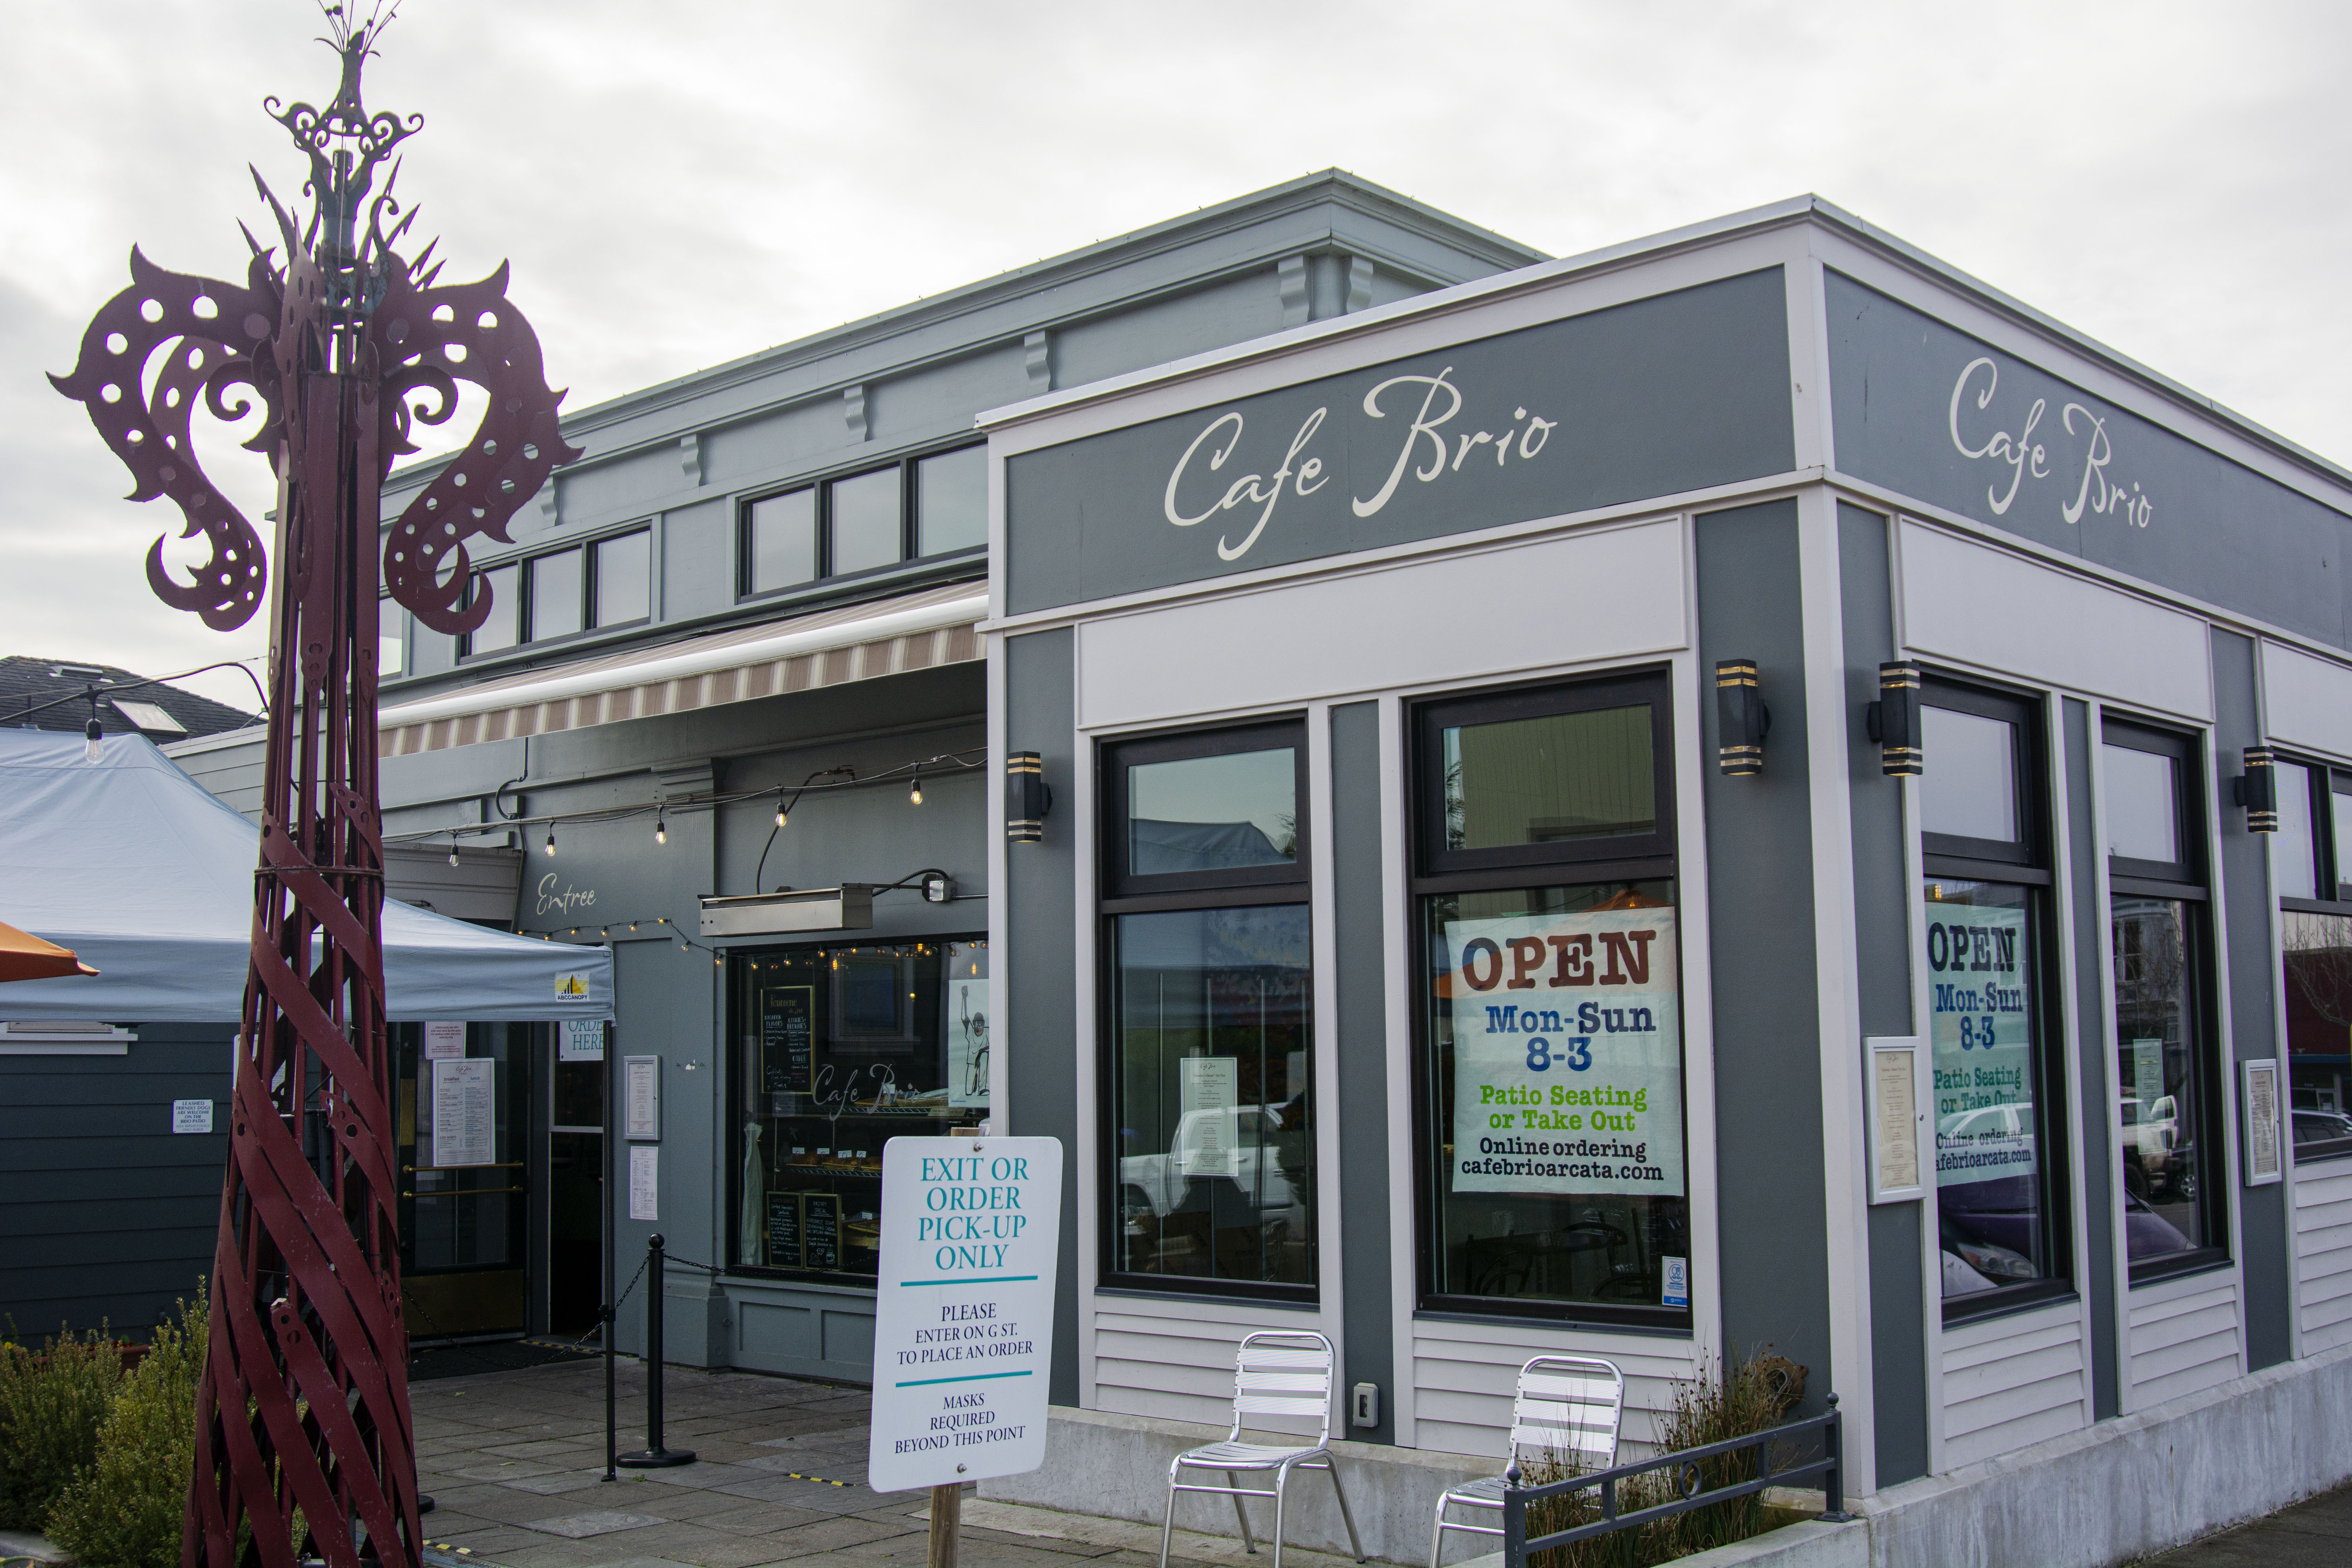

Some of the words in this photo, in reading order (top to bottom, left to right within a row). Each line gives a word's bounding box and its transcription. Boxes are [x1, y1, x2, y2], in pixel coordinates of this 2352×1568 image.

[1950, 357, 2050, 514] Cafe
[2063, 403, 2153, 528] Brio
[1164, 406, 1329, 561] Cafe
[1352, 366, 1558, 517] Brio
[537, 873, 596, 915] Entree
[1462, 929, 1657, 991] OPEN
[1928, 922, 2016, 972] OPEN
[1936, 981, 2023, 1012] Mon-Sun
[568, 1021, 603, 1032] ORDE
[1485, 1002, 1657, 1034] Mon-Sun
[1961, 1016, 1995, 1050] 8-3
[1526, 1037, 1593, 1072] 8-3
[1933, 1067, 1971, 1089] Patio
[1975, 1065, 2021, 1090] Seating
[813, 1064, 860, 1121] Cafe
[867, 1063, 921, 1114] Brio
[1479, 1085, 1542, 1106] Patio
[1551, 1085, 1647, 1112] Seating
[1941, 1098, 1957, 1113] or
[1961, 1092, 1991, 1111] Take
[1489, 1113, 1514, 1129] or
[1522, 1110, 1582, 1130] Take
[1591, 1110, 1635, 1131] Out
[1479, 1137, 1550, 1156] Online
[1553, 1138, 1646, 1163] ordering
[1936, 1131, 1974, 1149] Online
[1979, 1128, 2023, 1146] ordering
[920, 1157, 984, 1181] EXIT
[991, 1157, 1030, 1181] OR
[1461, 1158, 1664, 1180] cafebrioarcata.com
[1936, 1148, 2032, 1171] afebrioarcata.com
[927, 1186, 1022, 1211] ORDER
[918, 1215, 1027, 1241] PICK-UP
[936, 1244, 1009, 1270] ONLY
[941, 1302, 997, 1322] PLEASE
[915, 1327, 959, 1344] ENTER
[964, 1325, 984, 1339] ON
[988, 1325, 998, 1337] G
[1001, 1323, 1018, 1337] ST.
[897, 1351, 917, 1365] TO
[921, 1347, 963, 1363] PLACE
[965, 1345, 985, 1359] AN
[988, 1341, 1033, 1357] ORDER
[943, 1393, 985, 1410] MASKS
[930, 1410, 995, 1431] REQUIRED
[895, 1435, 949, 1454] BEYOND
[953, 1431, 983, 1446] THIS
[986, 1425, 1026, 1442] POINT
